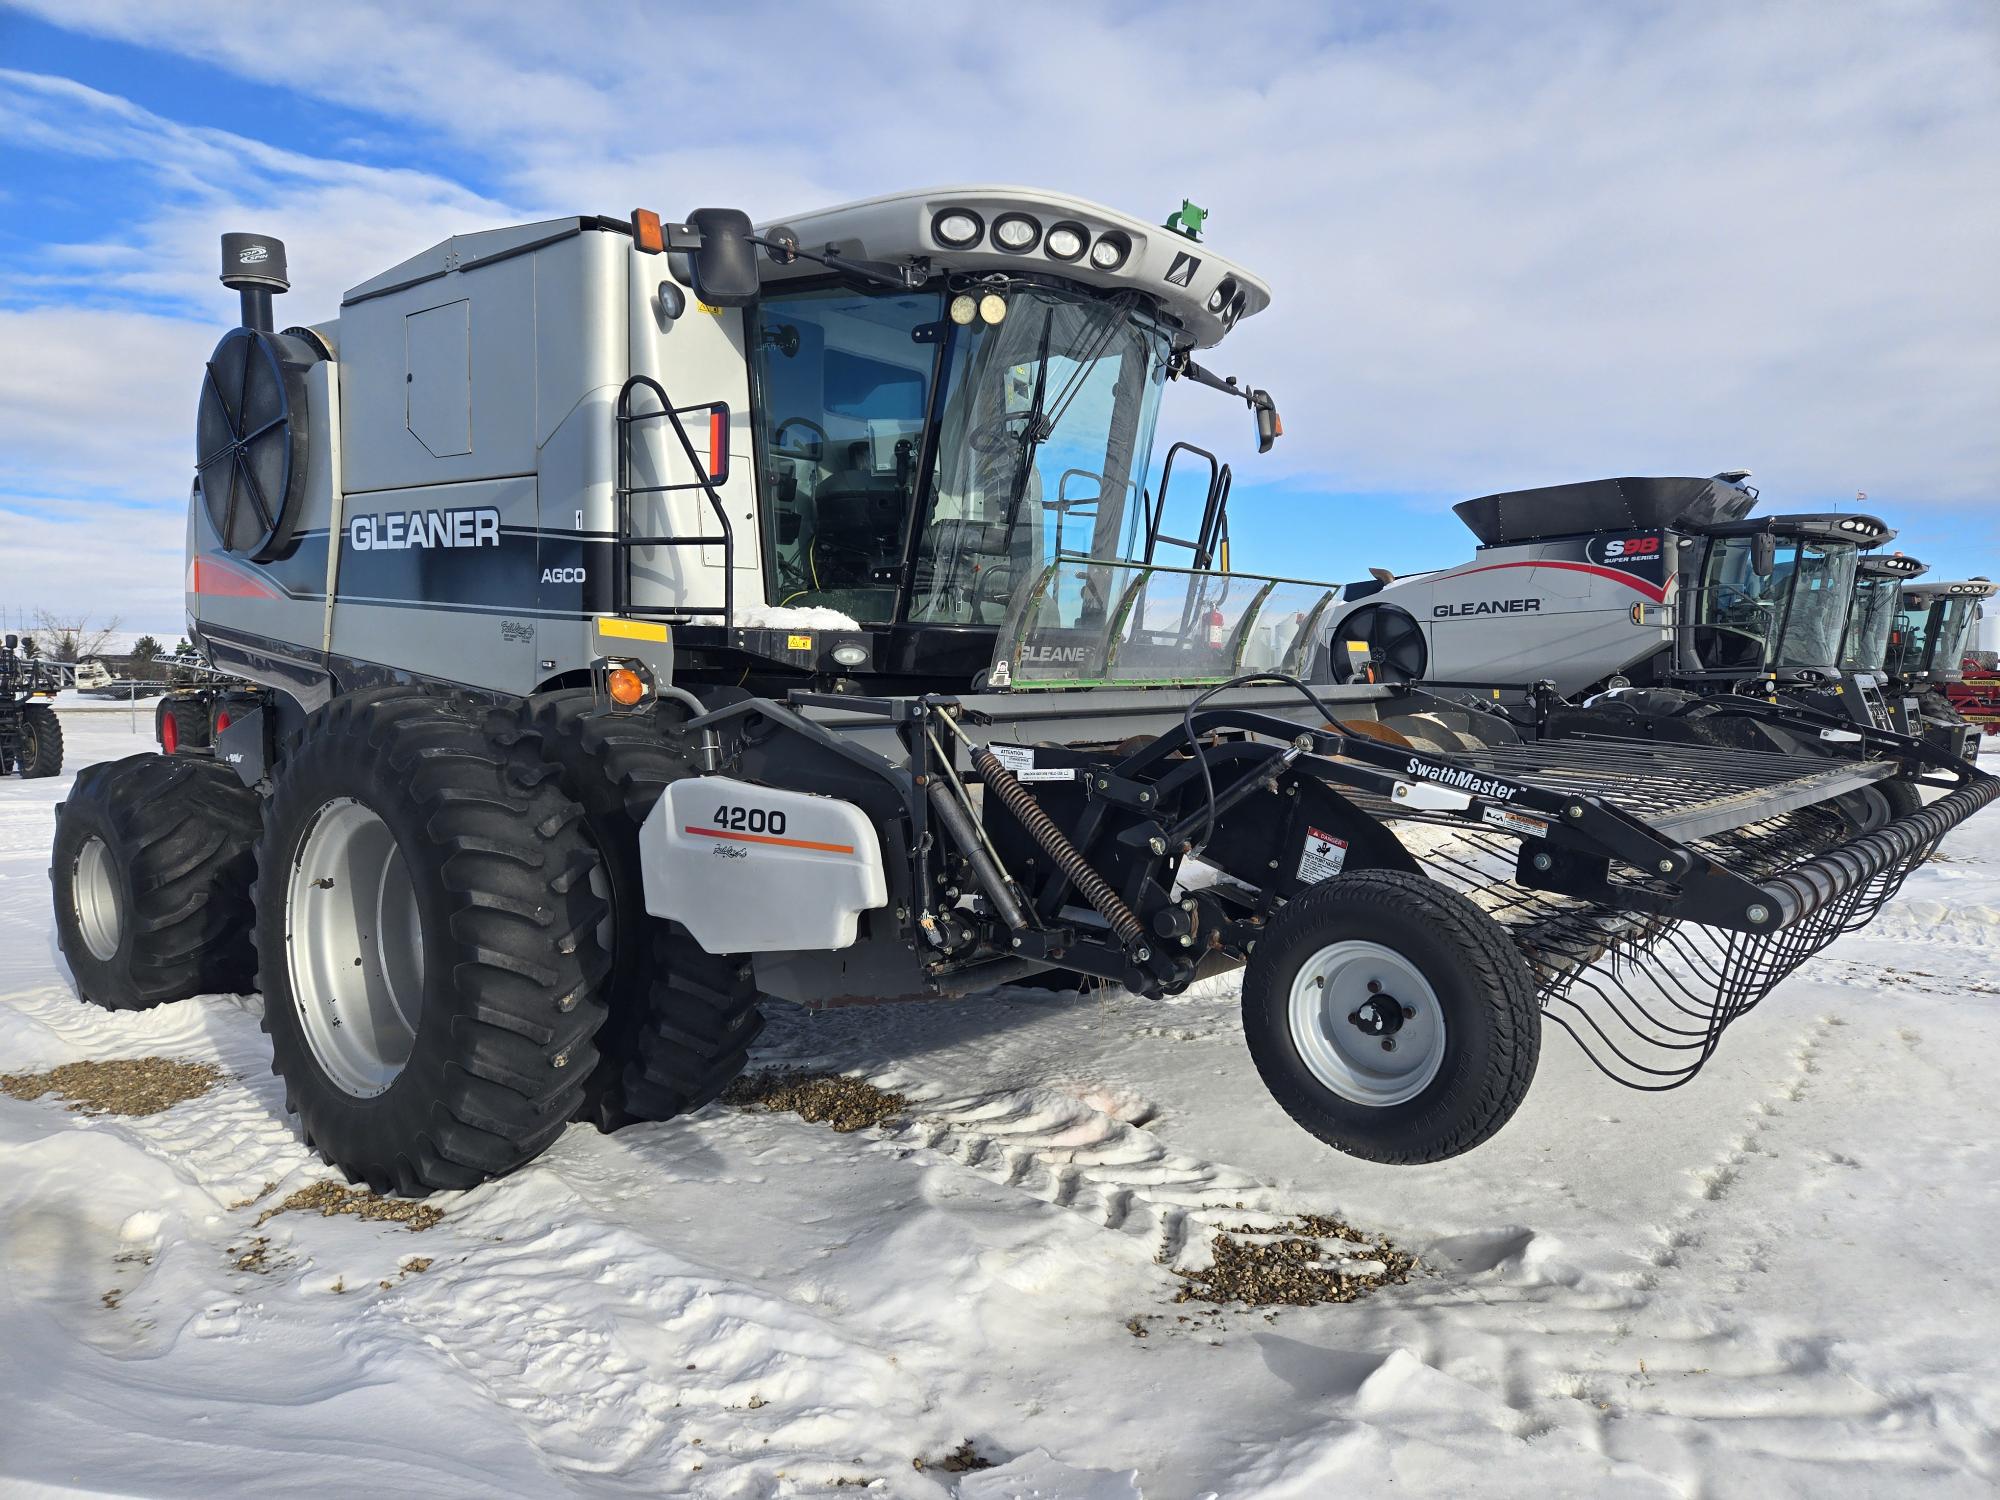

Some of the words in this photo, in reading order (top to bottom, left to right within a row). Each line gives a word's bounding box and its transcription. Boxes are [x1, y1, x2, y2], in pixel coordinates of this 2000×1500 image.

[351, 509, 500, 551] GLEANER
[1604, 536, 1659, 557] S98
[1604, 556, 1629, 564] SUPER
[1631, 554, 1660, 562] SERIES
[541, 567, 586, 584] AGCO
[1433, 599, 1541, 618] GLEANER
[1021, 645, 1085, 662] GLEANE
[1406, 758, 1517, 800] SwathMaster
[713, 805, 786, 835] 4200
